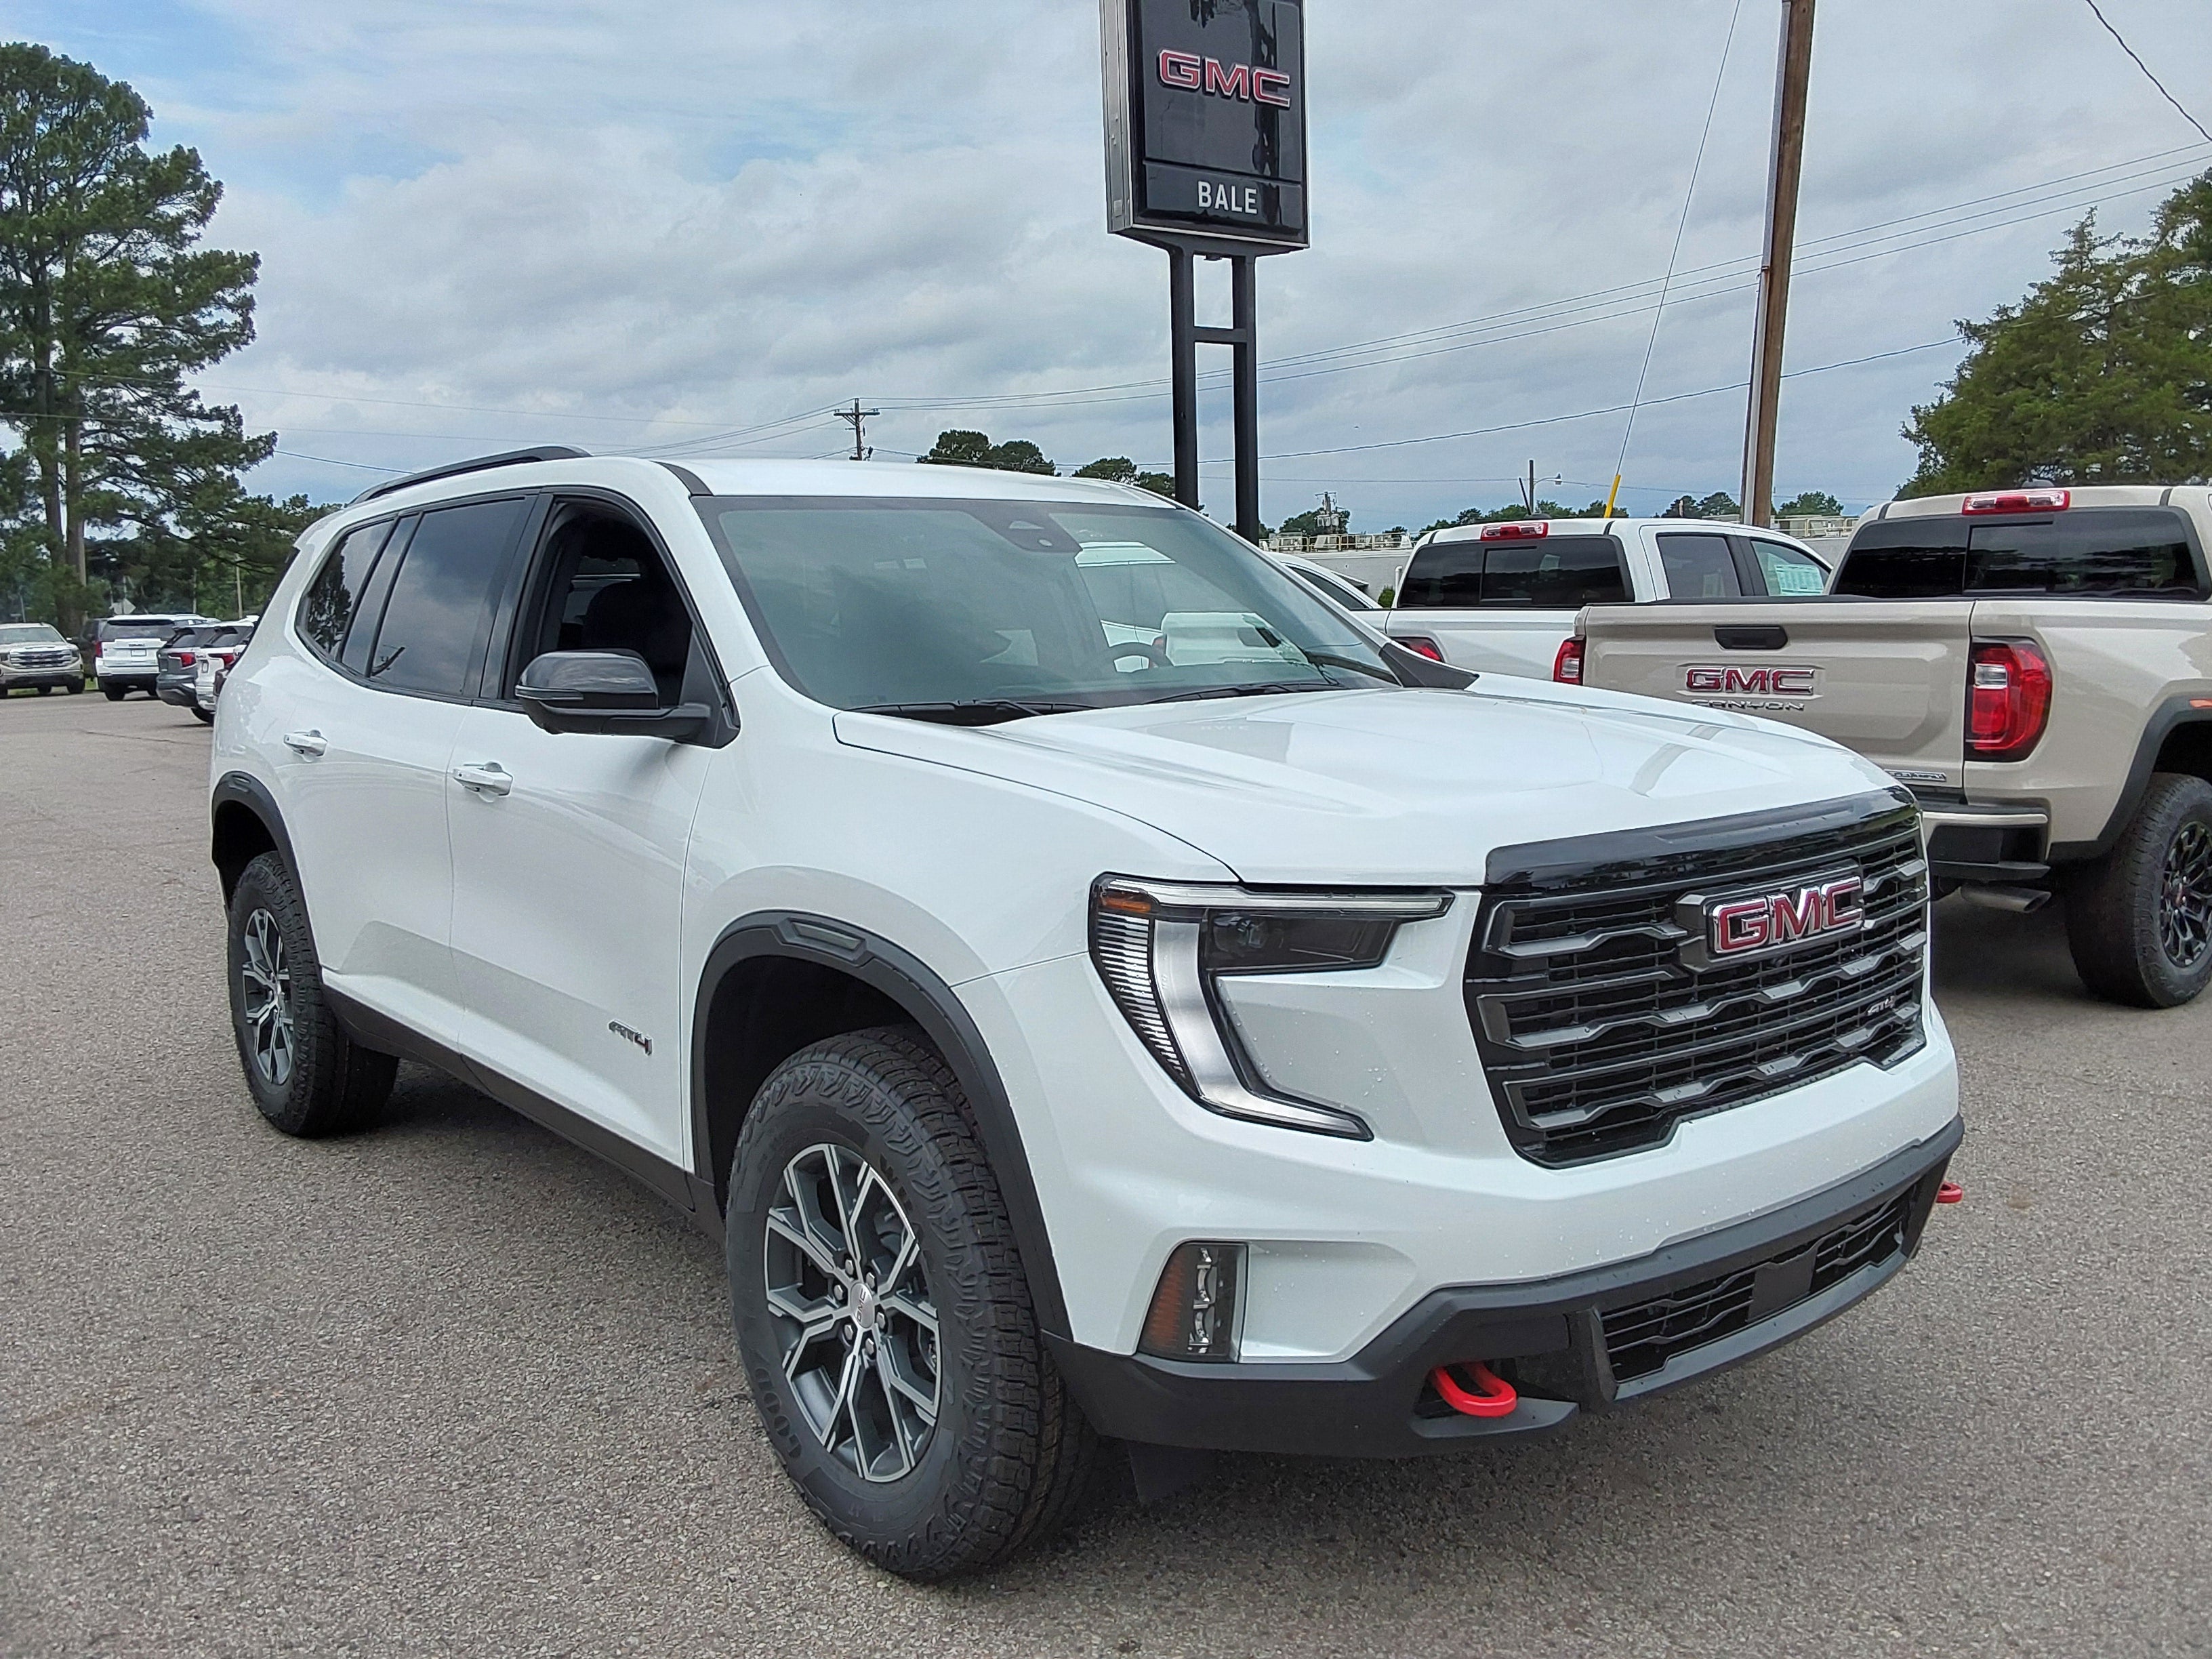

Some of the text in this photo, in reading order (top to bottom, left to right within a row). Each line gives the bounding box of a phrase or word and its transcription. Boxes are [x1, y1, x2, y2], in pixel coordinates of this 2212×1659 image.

[1159, 49, 1290, 108] GMC
[1197, 180, 1258, 214] BALE
[1685, 666, 1815, 696] GMC
[1691, 699, 1805, 712] CANYON
[1712, 876, 1864, 954] GMC
[857, 1288, 867, 1323] GMC
